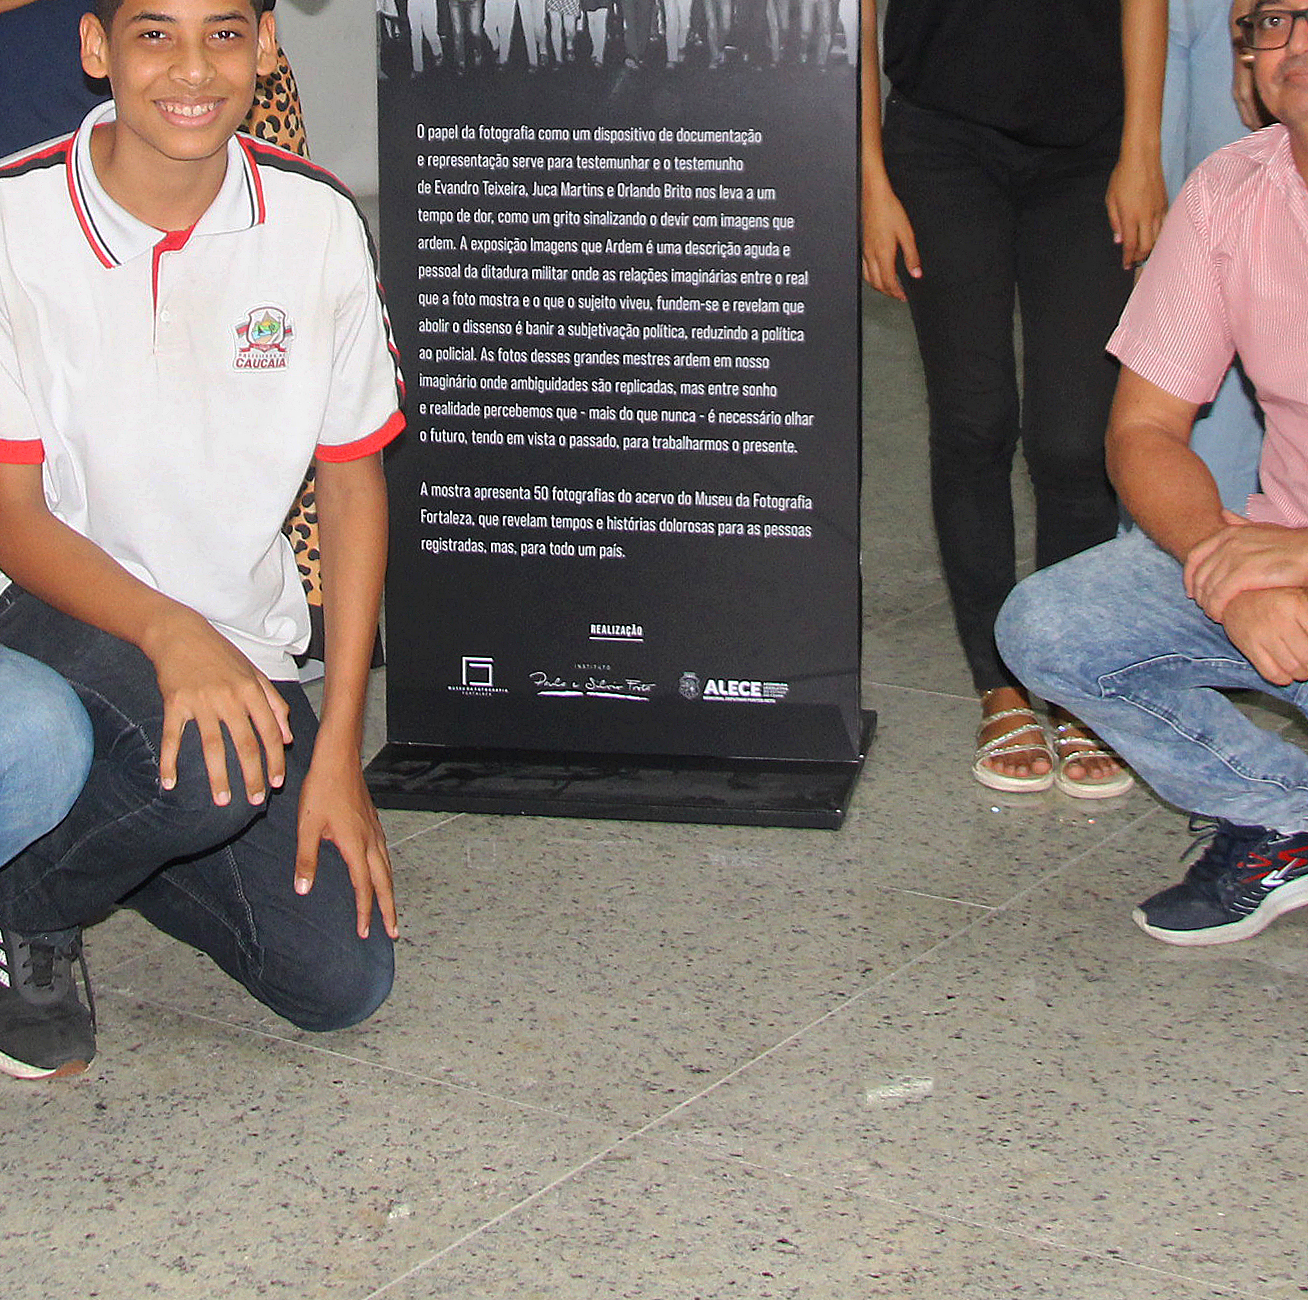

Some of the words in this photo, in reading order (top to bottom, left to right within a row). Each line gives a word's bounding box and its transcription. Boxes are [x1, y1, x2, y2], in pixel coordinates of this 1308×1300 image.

[416, 123, 425, 139] O
[427, 124, 458, 141] papel
[461, 124, 475, 139] da
[478, 124, 535, 143] fotografia
[538, 128, 570, 141] como
[572, 129, 591, 141] um
[593, 126, 656, 144] dispositivo
[658, 127, 674, 142] de
[676, 127, 762, 146] documentação
[417, 155, 425, 166] e
[427, 153, 509, 170] representação
[512, 156, 544, 168] serve
[547, 157, 573, 171] para
[576, 154, 650, 169] testemunhar
[652, 158, 661, 170] e
[663, 158, 671, 170] o
[673, 156, 744, 171] testemunho
[417, 179, 432, 194] de
[434, 179, 479, 195] Evandro
[531, 181, 558, 197] Juca
[560, 181, 604, 197] Martins
[606, 186, 615, 197] e
[617, 182, 661, 198] Orlando
[663, 183, 692, 199] Brito
[695, 187, 717, 199] nos
[719, 184, 744, 199] leva
[746, 188, 754, 200] a
[756, 188, 776, 200] um
[417, 208, 454, 225] tempo
[456, 207, 471, 223] de
[497, 211, 529, 224] como
[531, 212, 550, 224] um
[553, 210, 581, 227] grito
[583, 210, 647, 226] sinalizando
[649, 214, 657, 226] o
[660, 211, 690, 227] devir
[692, 215, 718, 227] com
[720, 212, 770, 230] imagens
[772, 216, 795, 231] que
[417, 235, 456, 250] ardem.
[459, 235, 468, 250] A
[470, 237, 527, 254] exposição
[530, 237, 578, 255] Imagens
[581, 241, 602, 255] que
[604, 238, 643, 254] Ardem
[645, 239, 654, 254] é
[656, 243, 682, 255] uma
[684, 240, 741, 258] descrição
[743, 241, 780, 259] aguda
[782, 245, 791, 257] e
[418, 263, 461, 279] pessoal
[463, 263, 478, 278] da
[481, 263, 529, 279] ditadura
[531, 265, 569, 280] militar
[571, 266, 599, 281] onde
[602, 269, 616, 281] as
[619, 267, 668, 285] relações
[670, 268, 738, 286] imaginárias
[740, 270, 772, 285] entre
[774, 273, 783, 285] o
[785, 270, 809, 285] real
[418, 317, 450, 333] abolir
[452, 321, 460, 333] o
[462, 318, 512, 334] dissenso
[515, 320, 523, 335] é
[525, 320, 555, 335] banir
[557, 324, 565, 336] a
[567, 321, 640, 340] subjetivação
[691, 324, 748, 340] reduzindo
[750, 329, 759, 340] a
[761, 326, 805, 343] política
[236, 357, 286, 368] CAUCAIA
[418, 348, 433, 360] ao
[435, 346, 477, 363] policial.
[480, 346, 495, 361] As
[497, 347, 528, 363] fotos
[530, 348, 571, 364] desses
[573, 350, 620, 367] grandes
[622, 352, 671, 366] mestres
[673, 352, 711, 367] ardem
[713, 355, 732, 368] em
[735, 356, 770, 369] nosso
[419, 372, 477, 391] imaginário
[479, 374, 508, 390] onde
[510, 375, 589, 393] ambiguidades
[591, 378, 612, 392] são
[680, 383, 705, 395] mas
[707, 381, 739, 396] entre
[741, 382, 777, 397] sonho
[419, 430, 427, 442] o
[471, 429, 504, 445] tendo
[506, 433, 525, 445] em
[527, 431, 556, 446] vista
[558, 435, 566, 446] o
[622, 437, 649, 451] para
[651, 435, 729, 451] trabalharmos
[731, 440, 740, 452] o
[742, 439, 798, 454] presente.
[420, 481, 429, 496] A
[431, 484, 471, 498] mostra
[473, 486, 531, 501] apresenta
[533, 485, 549, 501] 50
[551, 485, 615, 504] fotografias
[617, 488, 632, 503] do
[634, 492, 675, 505] acervo
[677, 490, 692, 505] do
[694, 491, 732, 507] Museu
[735, 492, 750, 507] da
[753, 492, 813, 511] Fotografia
[478, 514, 499, 528] que
[502, 512, 548, 527] revelam
[550, 514, 594, 531] tempos
[596, 518, 604, 530] e
[606, 515, 656, 532] histórias
[658, 517, 715, 533] dolorosas
[717, 522, 744, 536] para
[746, 524, 761, 535] as
[763, 524, 812, 538] pessoas
[520, 543, 546, 557] para
[549, 541, 575, 556] todo
[577, 545, 596, 557] um
[599, 543, 626, 559] país.
[590, 623, 643, 637] REALIZAÇÃO
[703, 679, 762, 697] ALECE
